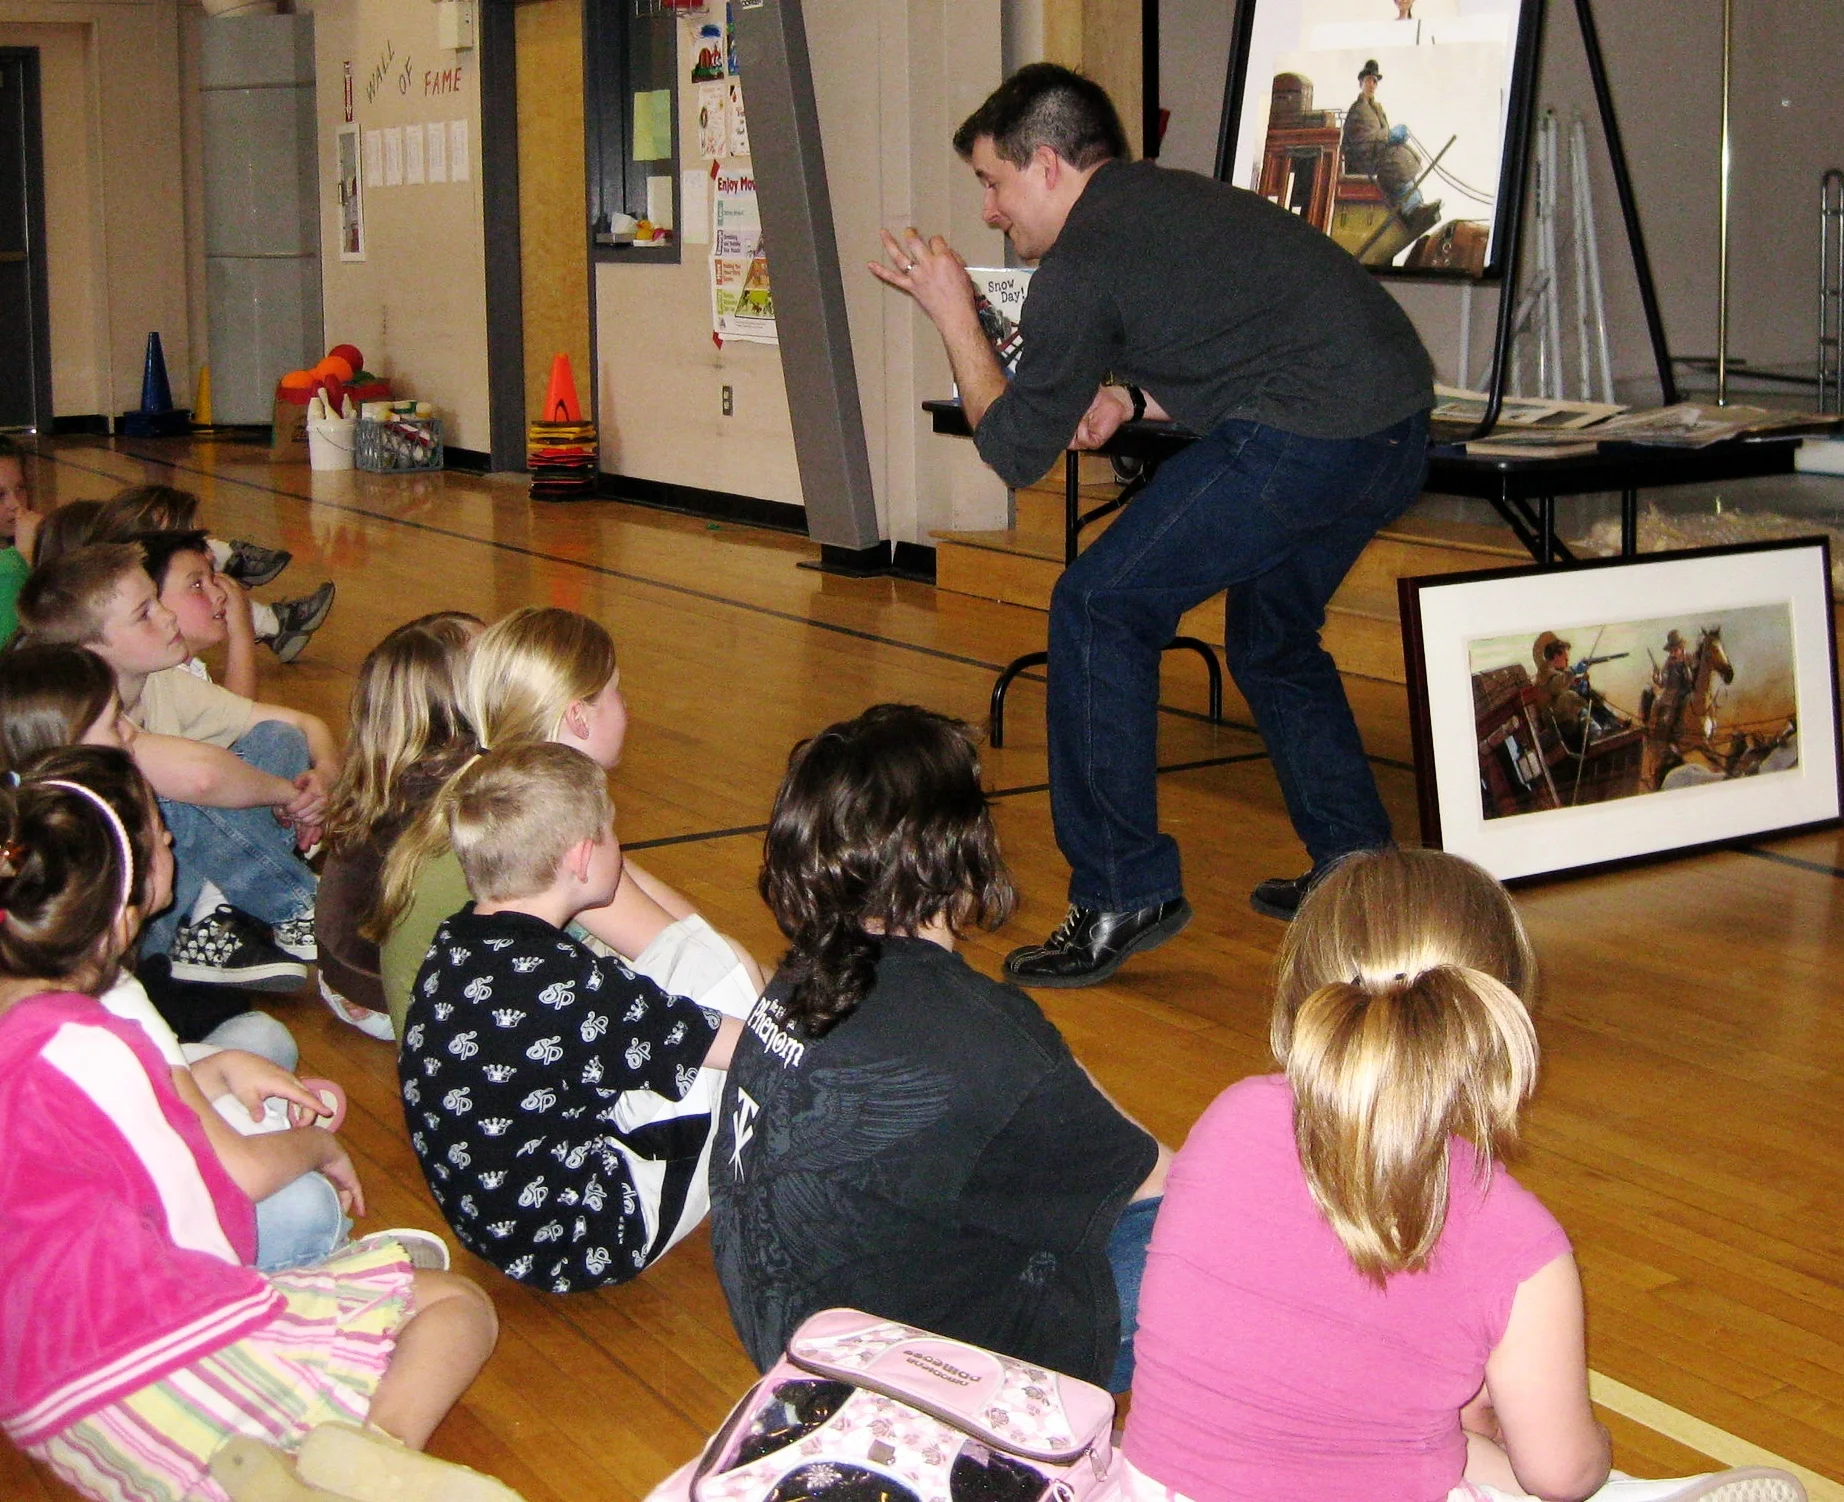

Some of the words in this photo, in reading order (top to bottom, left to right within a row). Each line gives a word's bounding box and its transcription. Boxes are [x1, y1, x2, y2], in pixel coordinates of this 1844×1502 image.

[366, 40, 395, 103] WALL
[399, 56, 412, 95] OF
[424, 67, 462, 97] FAME
[718, 177, 738, 194] Enjoy
[988, 279, 1015, 293] Snow
[1001, 287, 1025, 303] Day!
[747, 996, 805, 1069] Phenom
